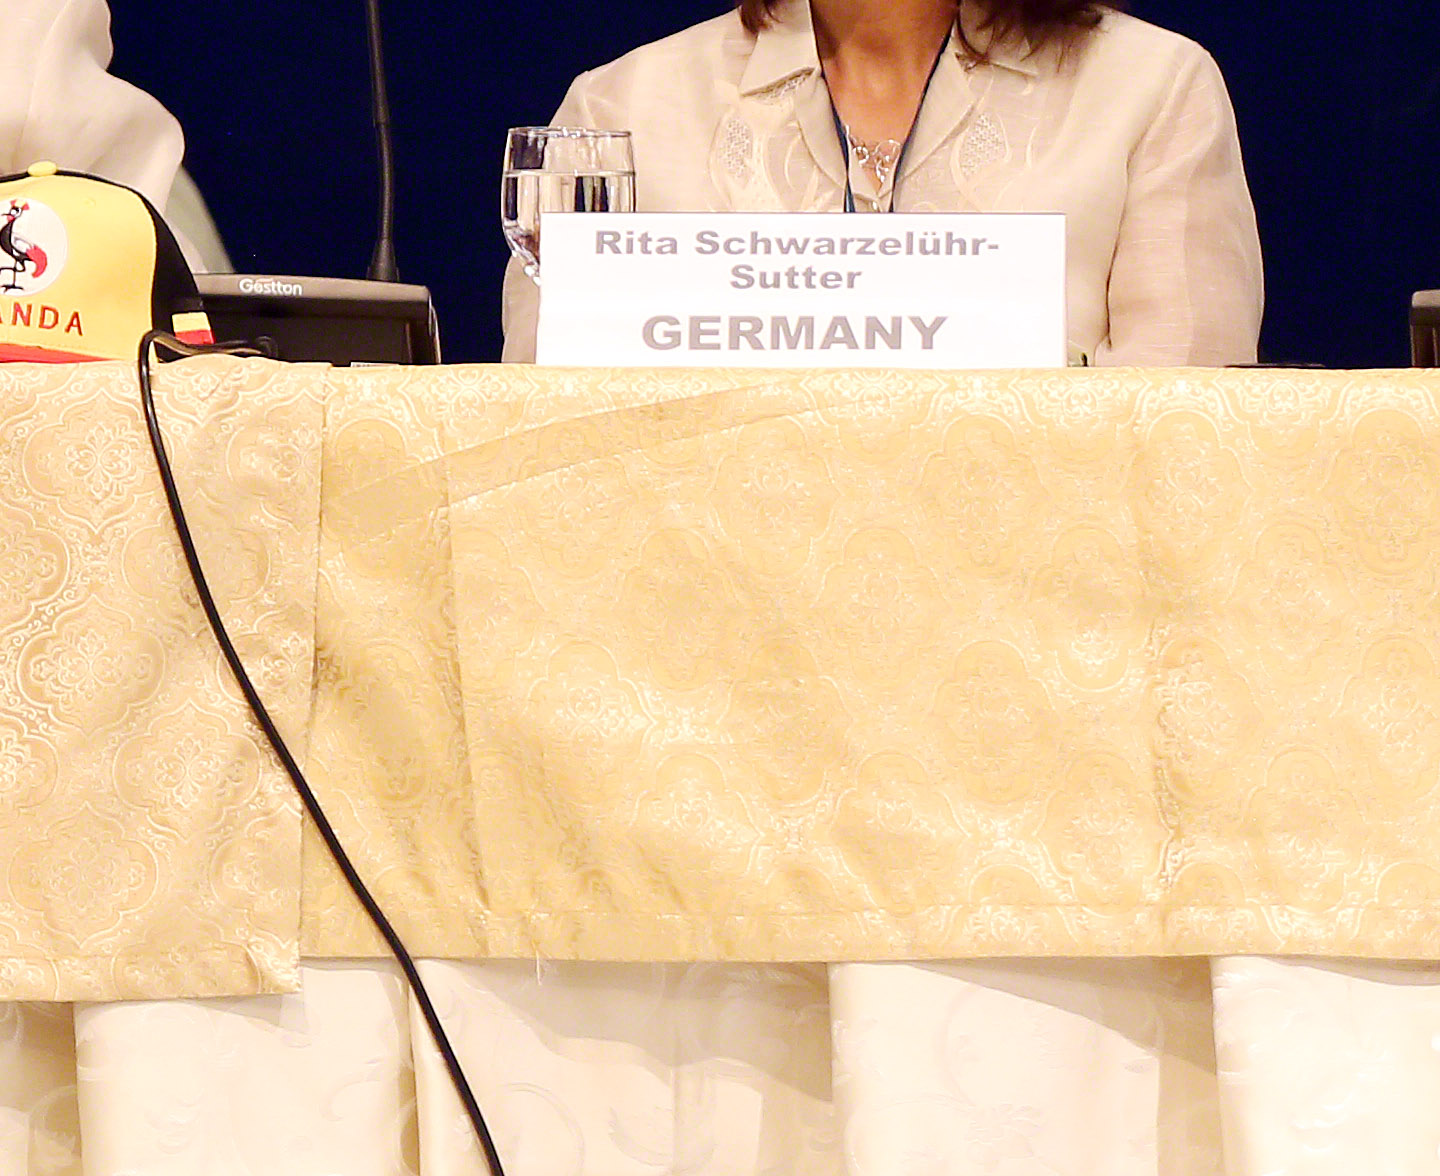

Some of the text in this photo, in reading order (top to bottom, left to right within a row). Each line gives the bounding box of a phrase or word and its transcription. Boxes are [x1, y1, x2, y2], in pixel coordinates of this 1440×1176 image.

[594, 228, 1000, 256] Rita Schwarzelühr-
[729, 263, 863, 290] Sutter
[641, 314, 948, 351] GERMANY
